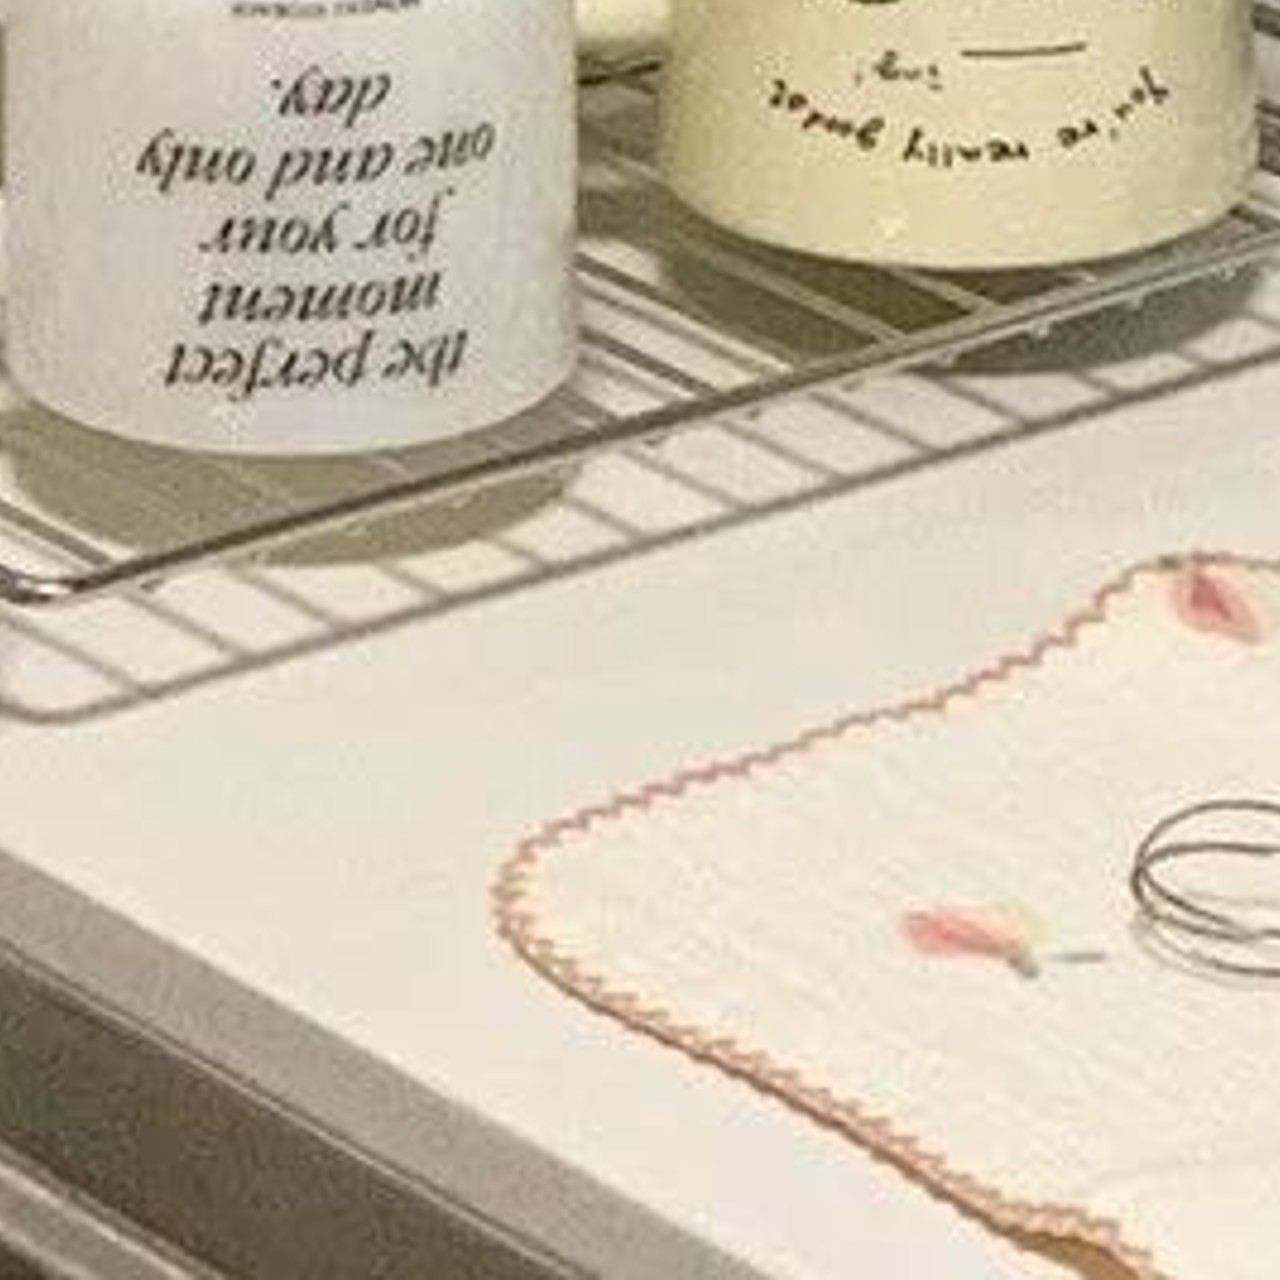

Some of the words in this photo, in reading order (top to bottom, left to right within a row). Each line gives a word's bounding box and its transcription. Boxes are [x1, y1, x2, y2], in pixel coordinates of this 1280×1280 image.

[271, 64, 393, 129] day.
[135, 127, 257, 193] only
[264, 142, 395, 202] and
[405, 121, 497, 177] one
[902, 125, 1030, 168] really
[197, 201, 351, 254] your
[354, 186, 456, 263] for
[197, 271, 442, 326] moment
[163, 329, 375, 403] perfect
[382, 329, 469, 387] the
